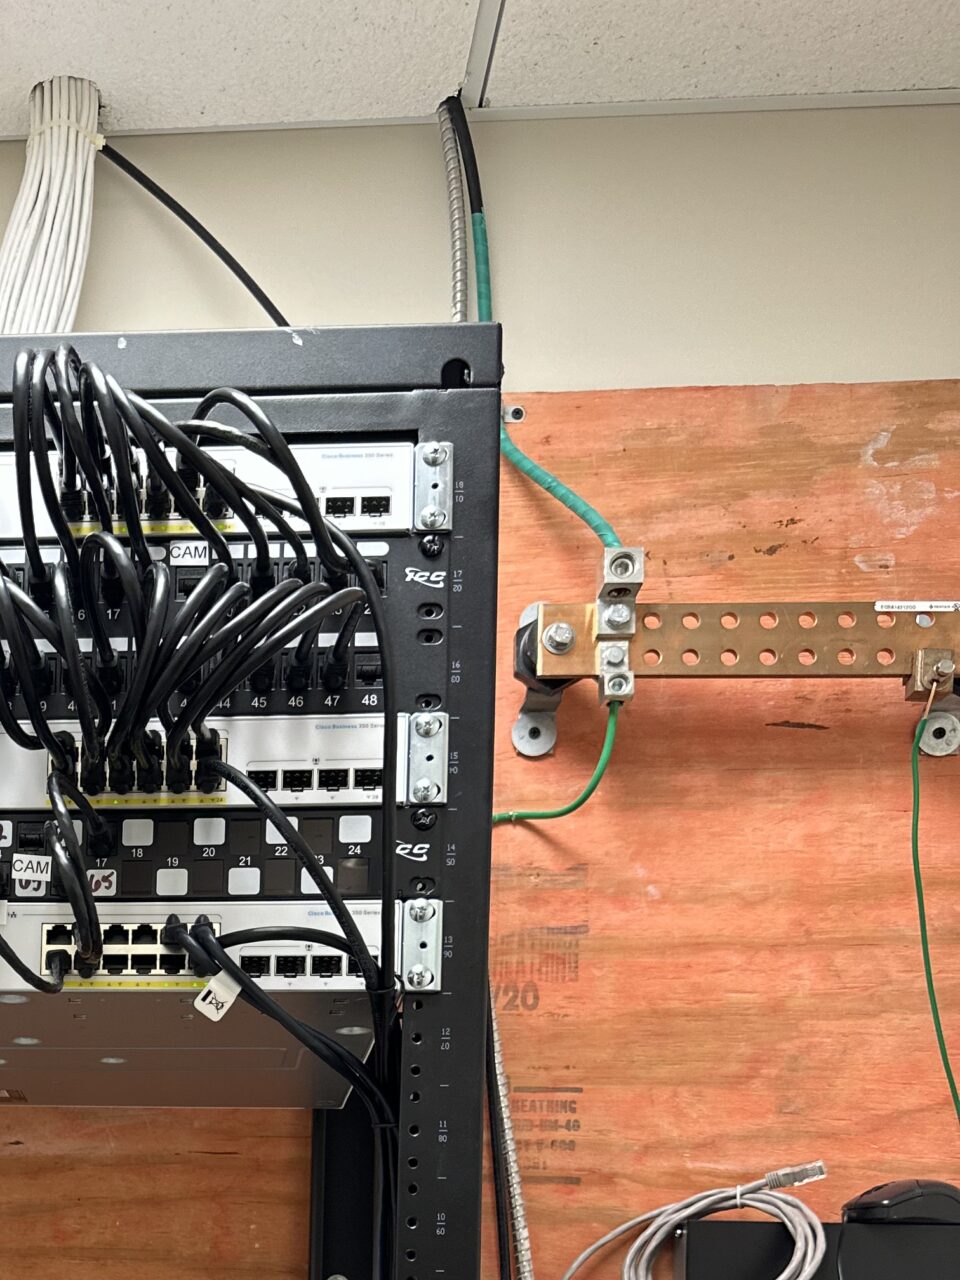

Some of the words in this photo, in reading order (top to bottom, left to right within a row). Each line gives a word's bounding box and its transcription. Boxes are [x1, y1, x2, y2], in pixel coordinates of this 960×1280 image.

[170, 545, 207, 559] CAM
[106, 608, 121, 620] 17
[251, 696, 268, 708] 45
[288, 696, 304, 708] 46
[324, 695, 340, 707] 47
[361, 694, 377, 706] 48
[131, 848, 144, 858] 18
[202, 847, 216, 857] 20
[275, 846, 289, 856] 22
[348, 844, 362, 855] 24
[12, 859, 51, 875] CAM
[95, 857, 108, 868] 17
[166, 857, 179, 867] 19
[238, 856, 252, 866] 21
